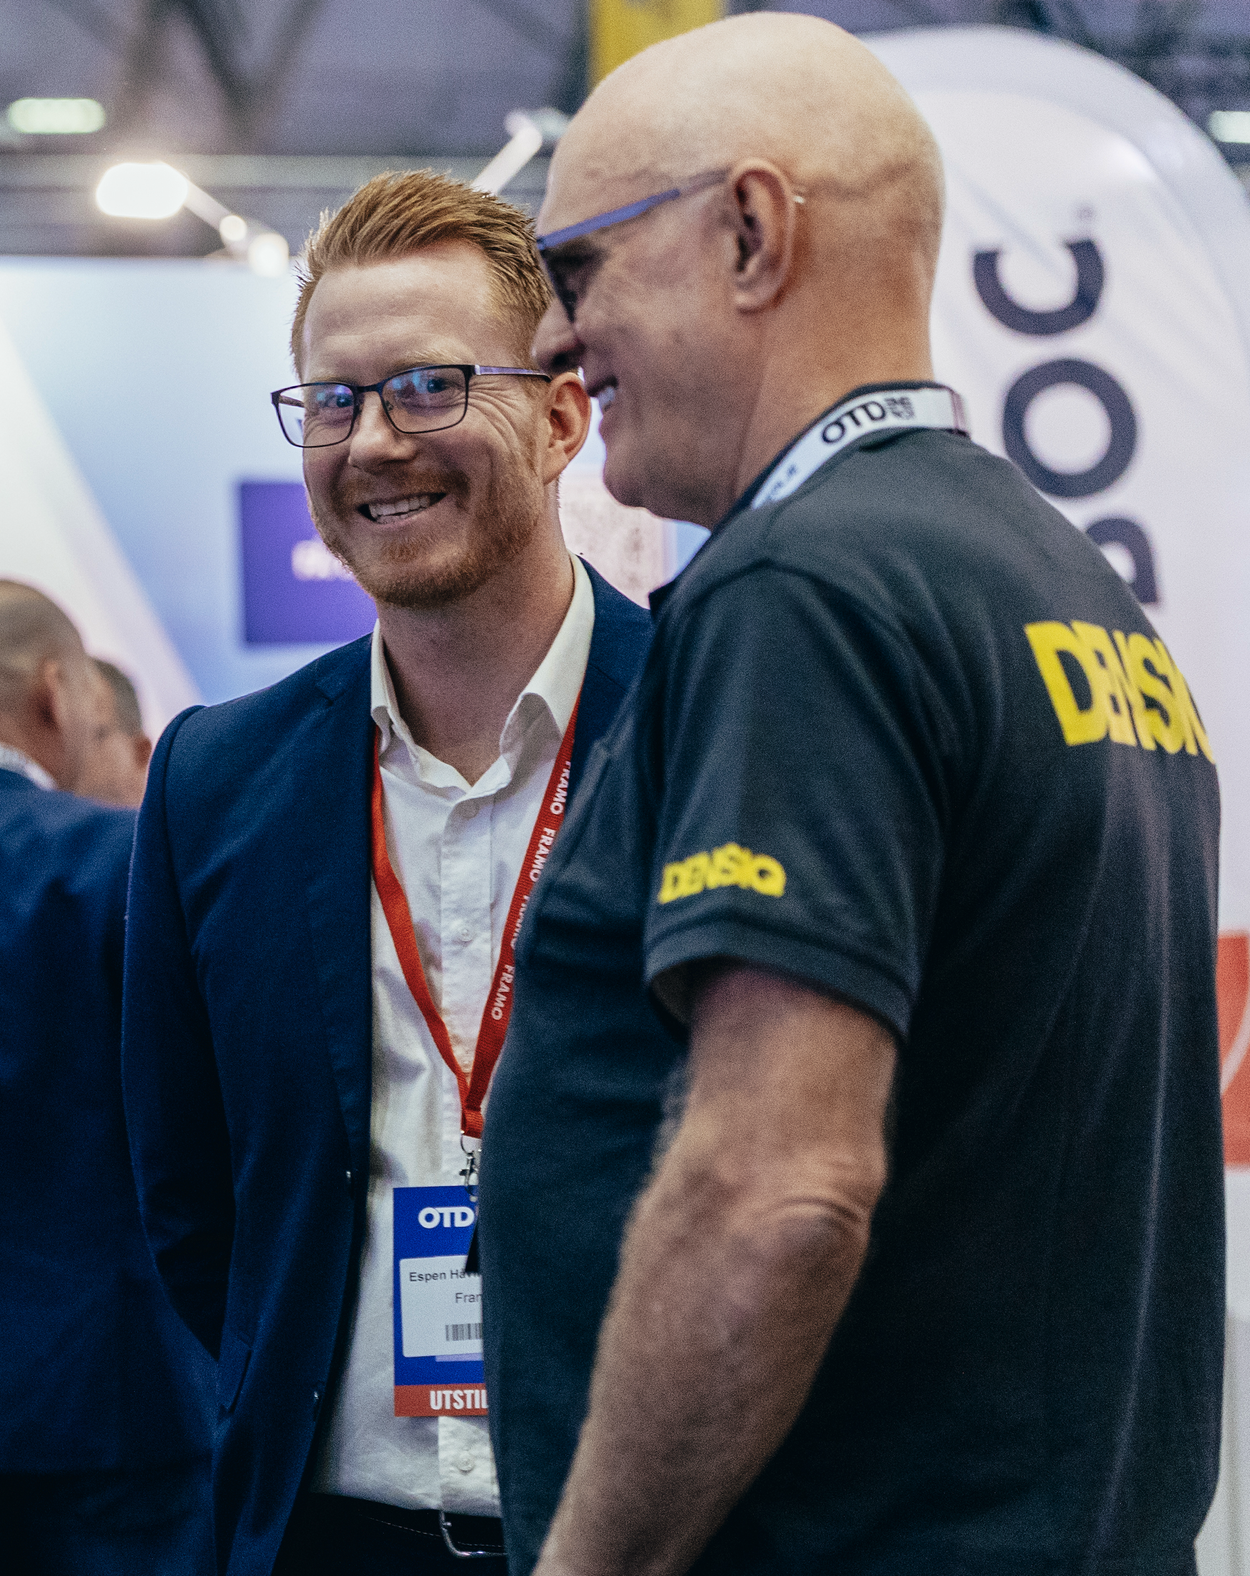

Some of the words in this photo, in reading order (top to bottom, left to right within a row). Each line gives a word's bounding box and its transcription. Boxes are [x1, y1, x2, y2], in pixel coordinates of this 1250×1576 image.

[822, 401, 886, 444] OTD
[658, 841, 787, 905] DENSIQ
[418, 1206, 475, 1229] OTD
[409, 1271, 447, 1283] Espen
